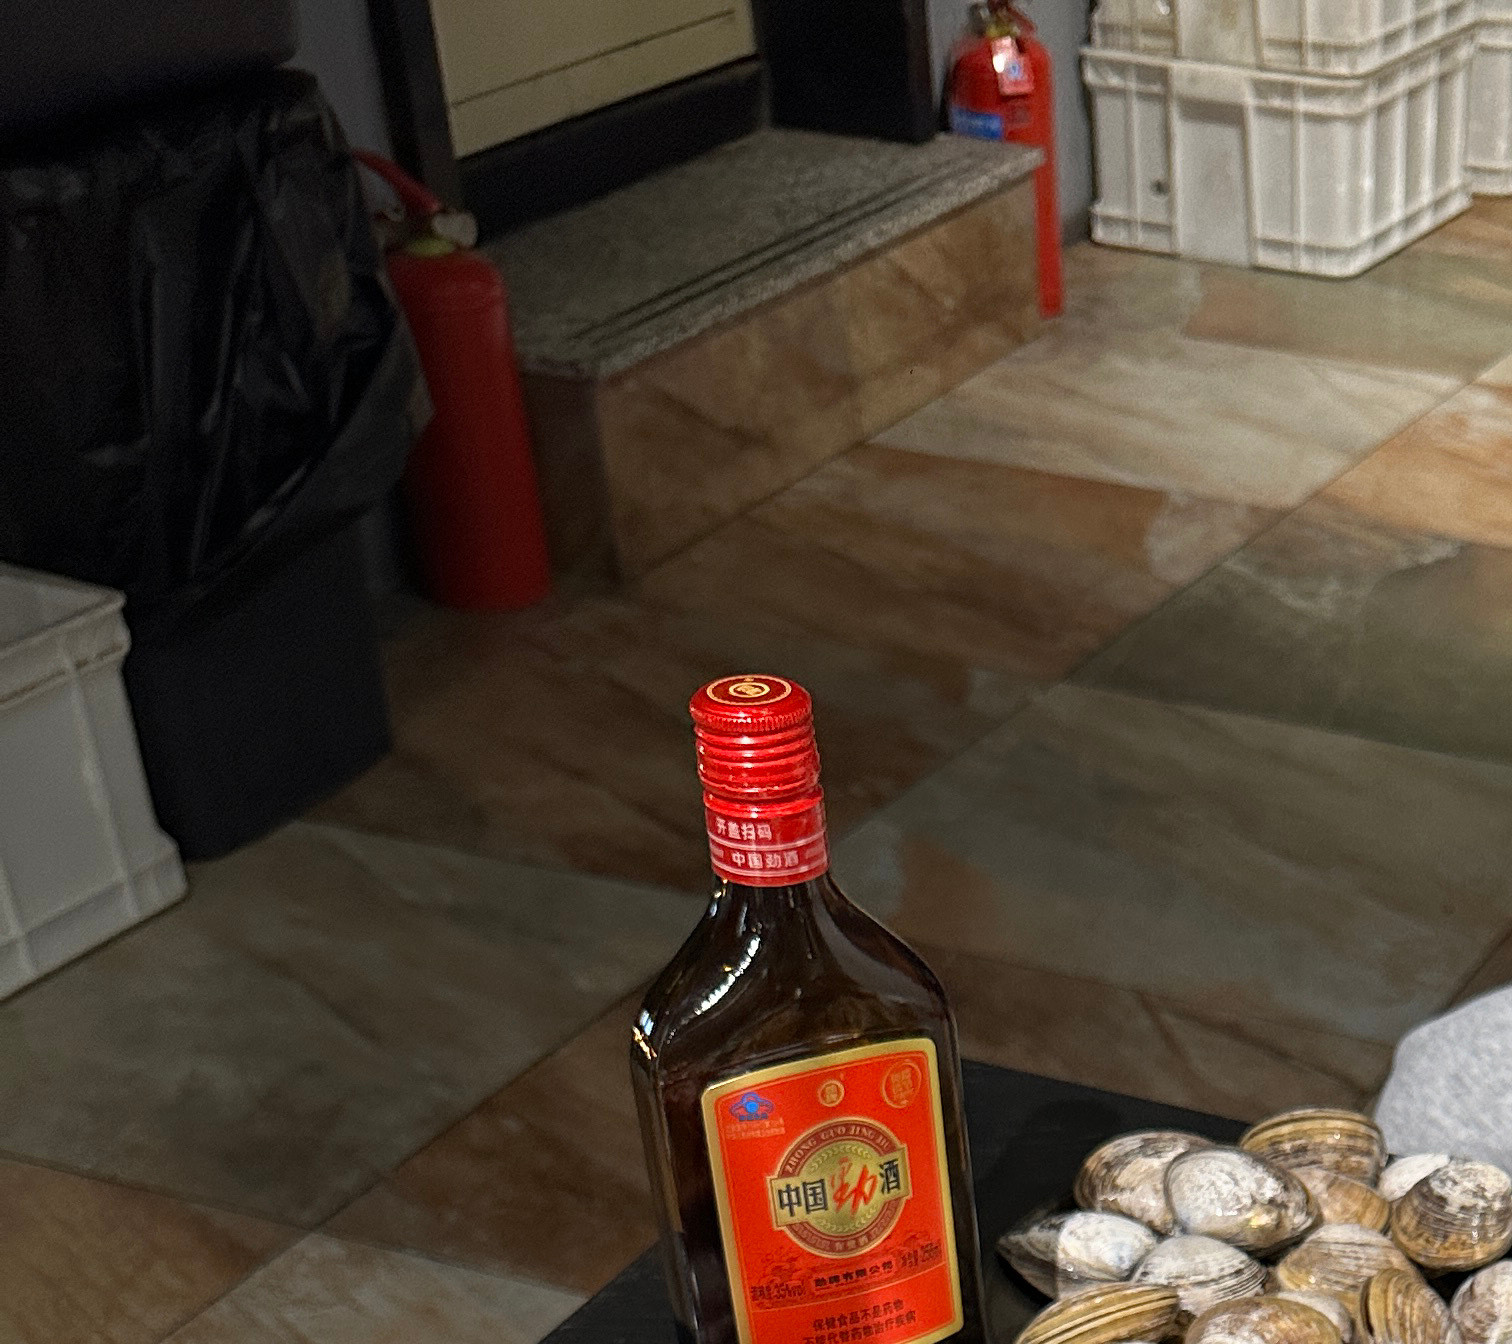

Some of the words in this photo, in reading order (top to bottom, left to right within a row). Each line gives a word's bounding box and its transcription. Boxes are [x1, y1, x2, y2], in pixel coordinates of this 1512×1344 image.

[715, 816, 773, 841] 开盖扫码
[731, 850, 799, 869] 中国劲酒
[785, 1137, 817, 1174] ZHONG
[777, 1156, 901, 1218] 中国劲酒
